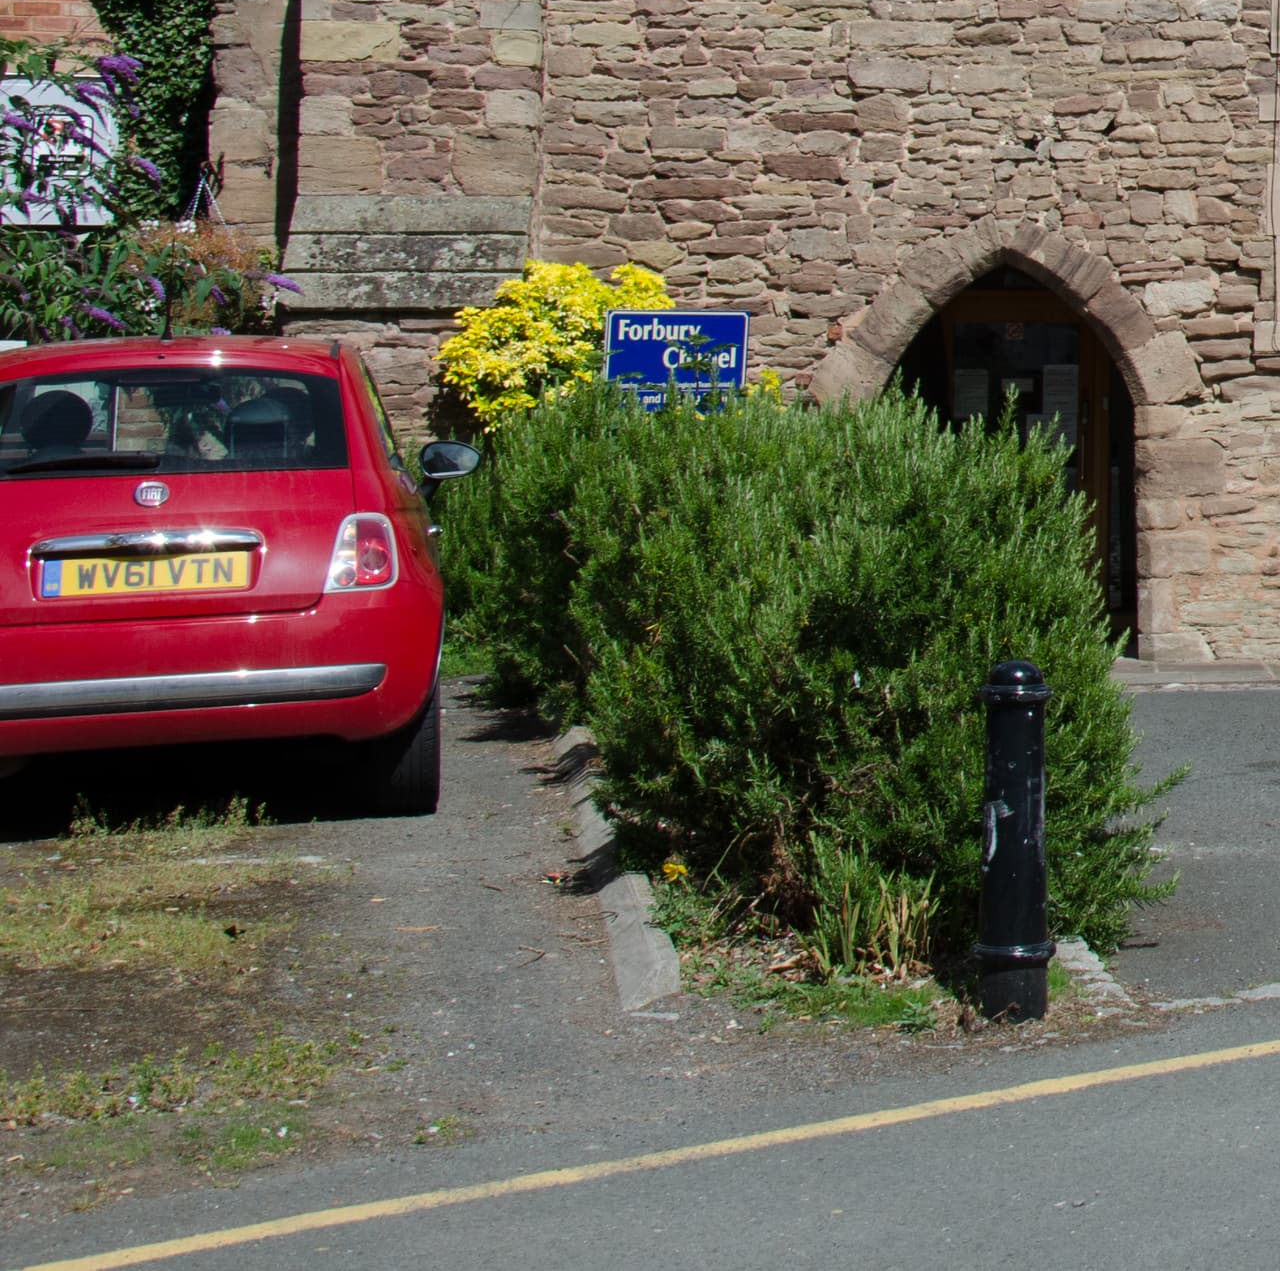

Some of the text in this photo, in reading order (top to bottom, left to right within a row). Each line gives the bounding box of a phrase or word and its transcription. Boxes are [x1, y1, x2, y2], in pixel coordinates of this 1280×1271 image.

[618, 318, 701, 344] Forbury
[662, 346, 737, 368] Chel
[642, 393, 661, 404] and
[141, 487, 163, 500] FIAT
[76, 557, 234, 590] WV61 VTN
